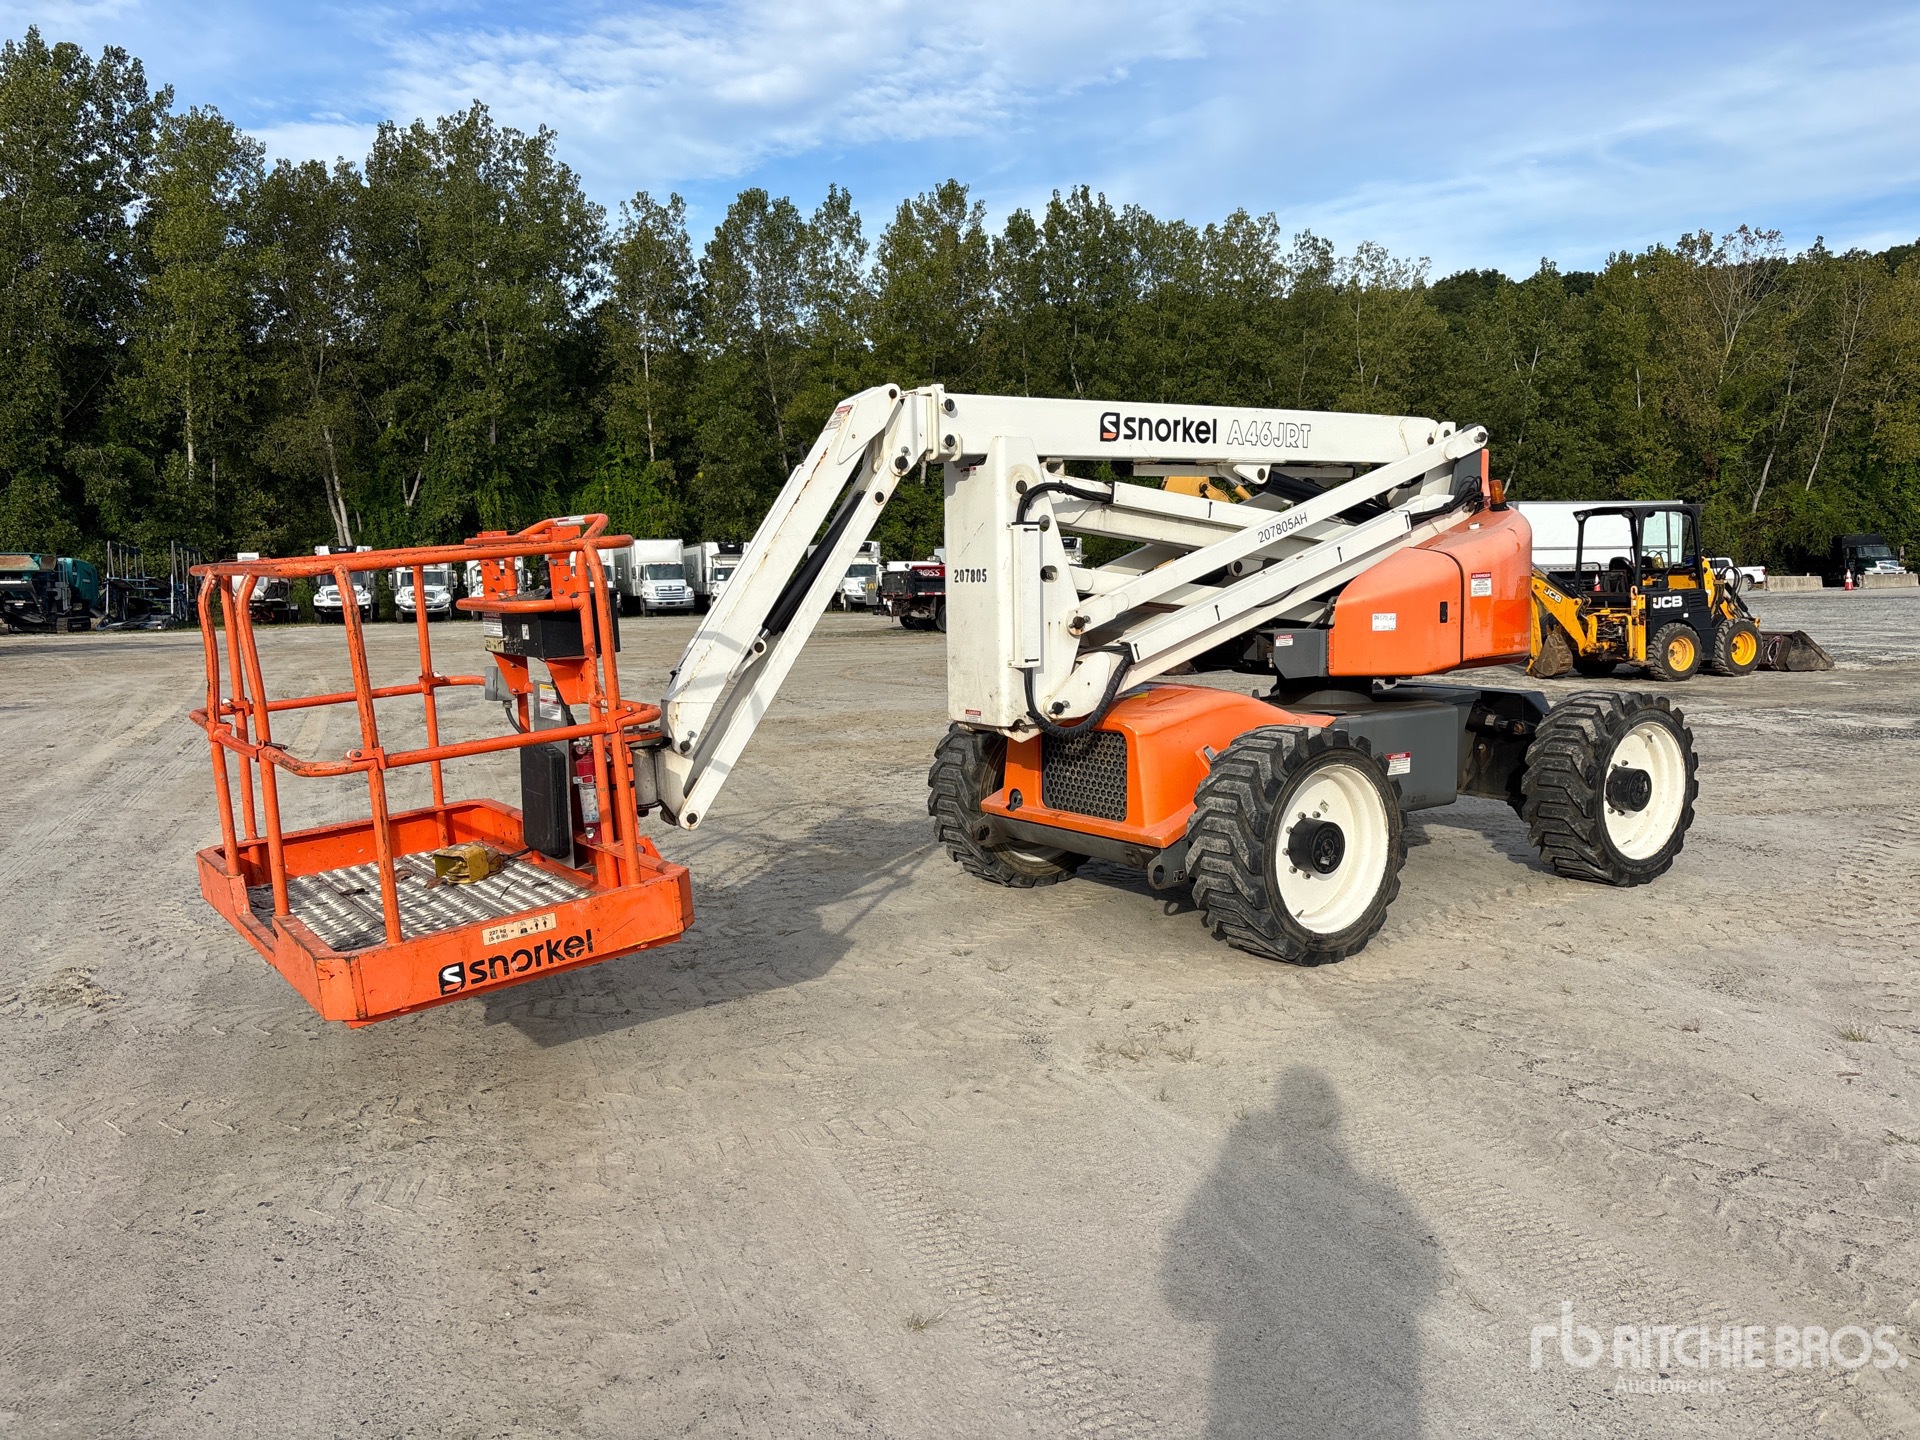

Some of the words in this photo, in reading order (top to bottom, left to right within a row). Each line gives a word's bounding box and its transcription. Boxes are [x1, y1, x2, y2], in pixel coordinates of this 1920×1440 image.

[1123, 416, 1217, 444] snorkel
[1227, 419, 1311, 448] A46JRT
[1257, 512, 1308, 543] 207805AH
[954, 568, 987, 583] 207805
[1544, 586, 1562, 603] JCB
[1652, 595, 1683, 609] JCB
[469, 929, 594, 985] snorkel
